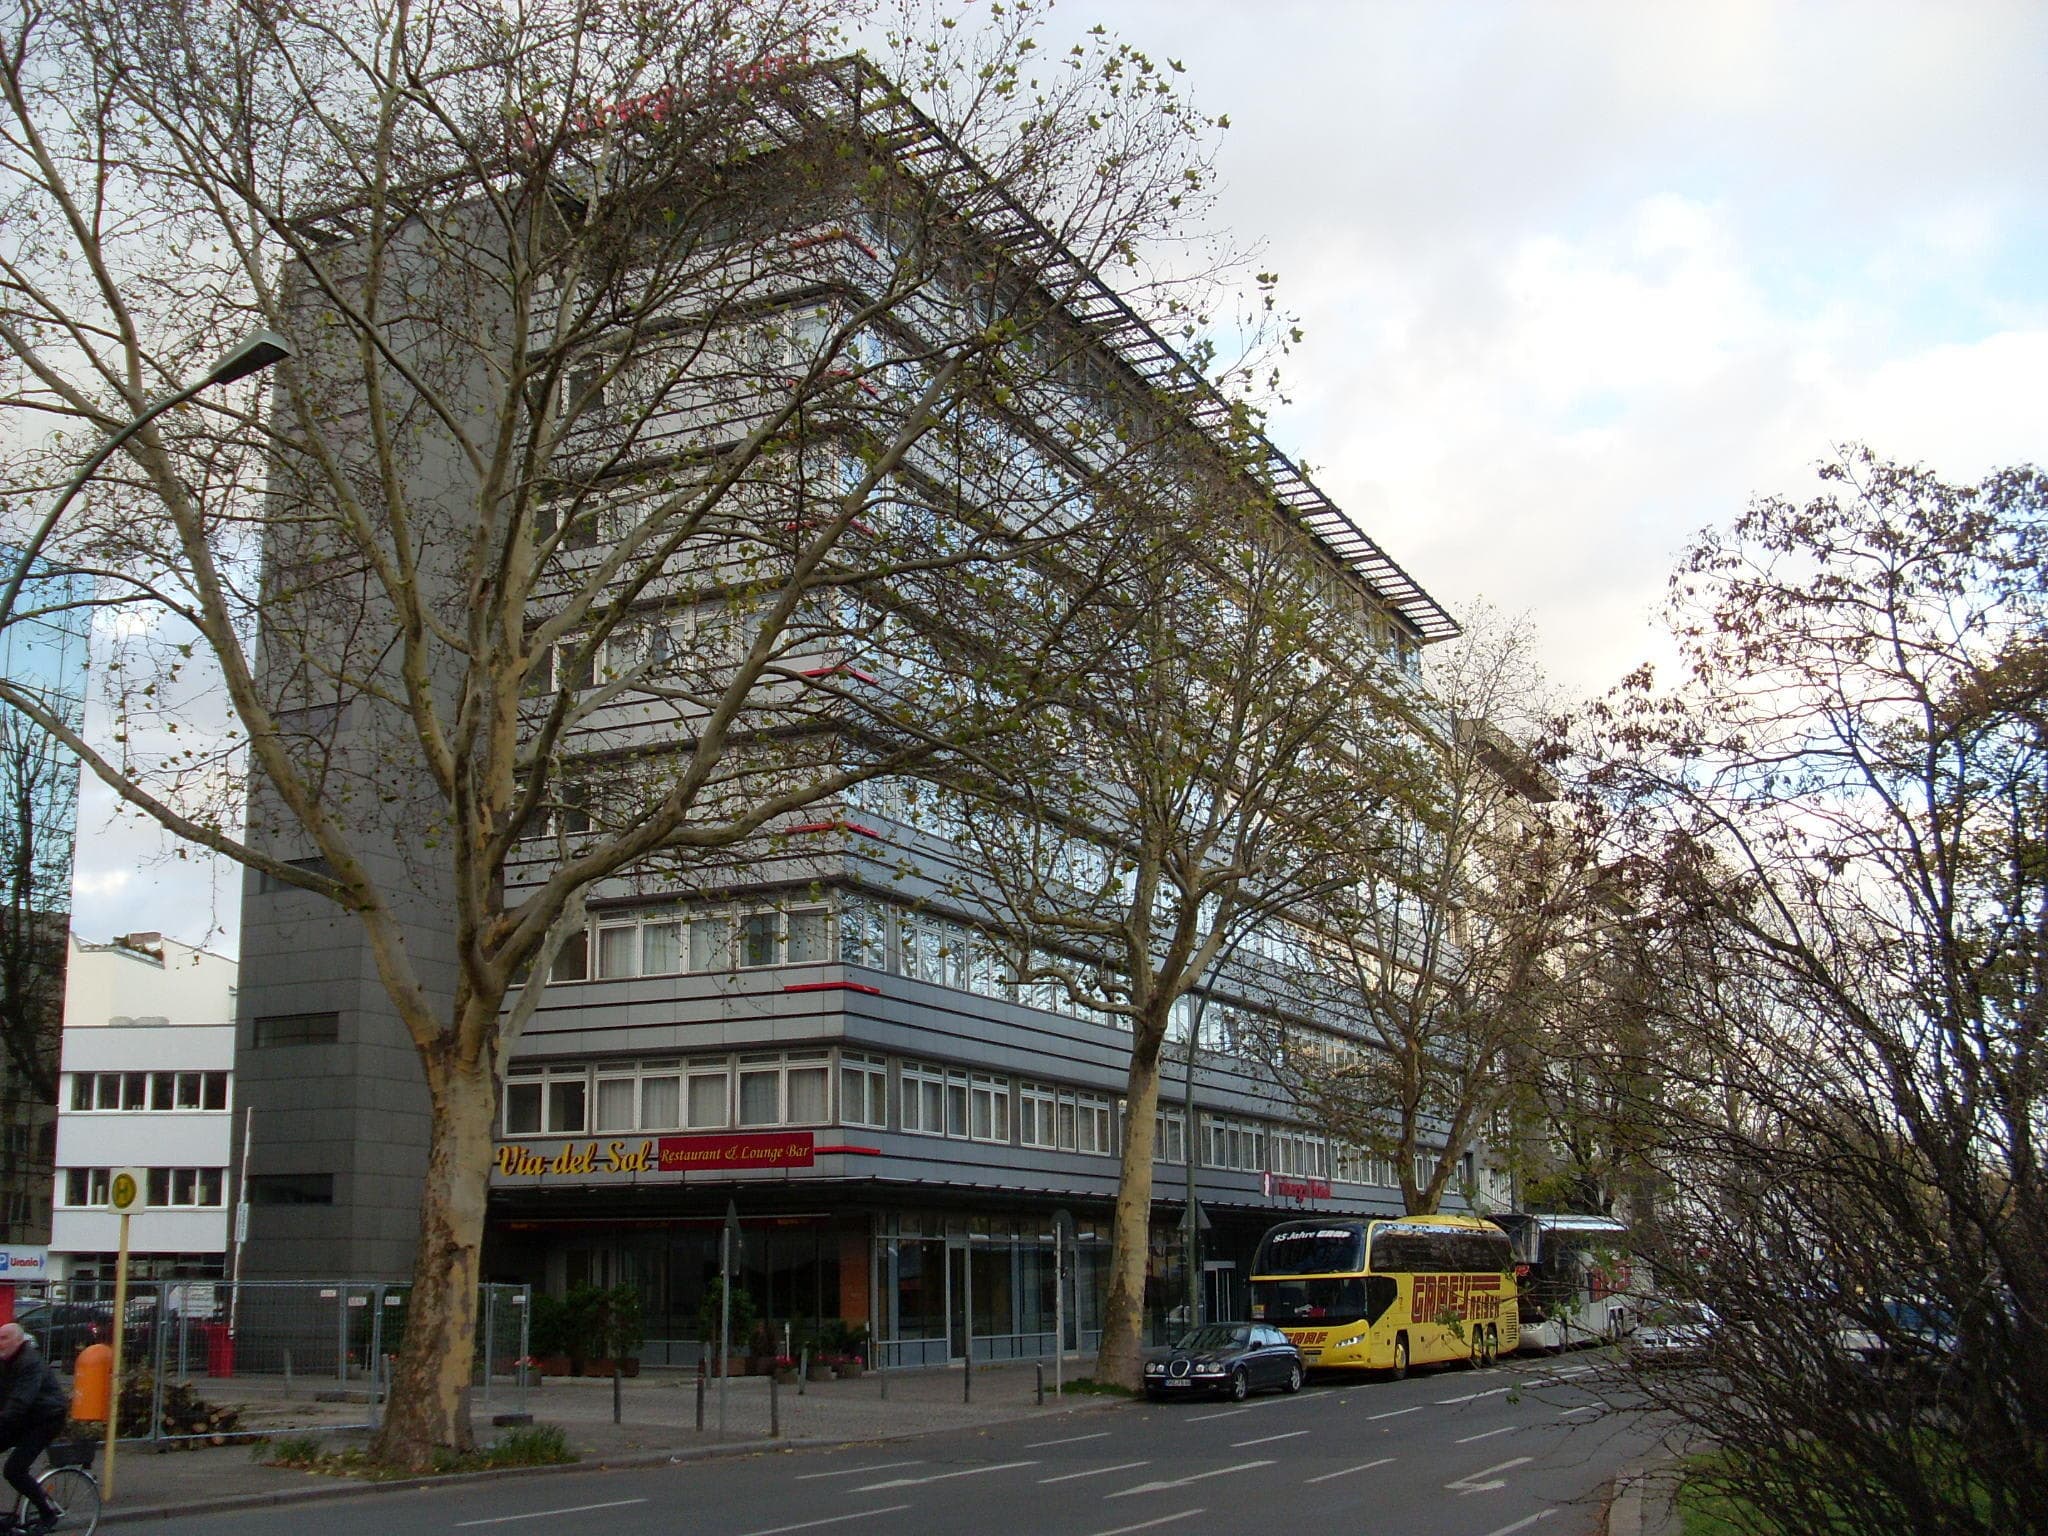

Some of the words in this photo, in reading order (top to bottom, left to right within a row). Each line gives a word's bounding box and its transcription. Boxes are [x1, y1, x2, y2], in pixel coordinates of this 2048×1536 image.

[499, 1146, 546, 1176] Via
[551, 1143, 597, 1174] del
[603, 1140, 652, 1173] Sol
[659, 1149, 721, 1163] Restaurant
[740, 1145, 784, 1162] Lounge
[785, 1144, 810, 1158] Bar
[1287, 1231, 1316, 1241] Jahre
[10, 1257, 39, 1267] Urania
